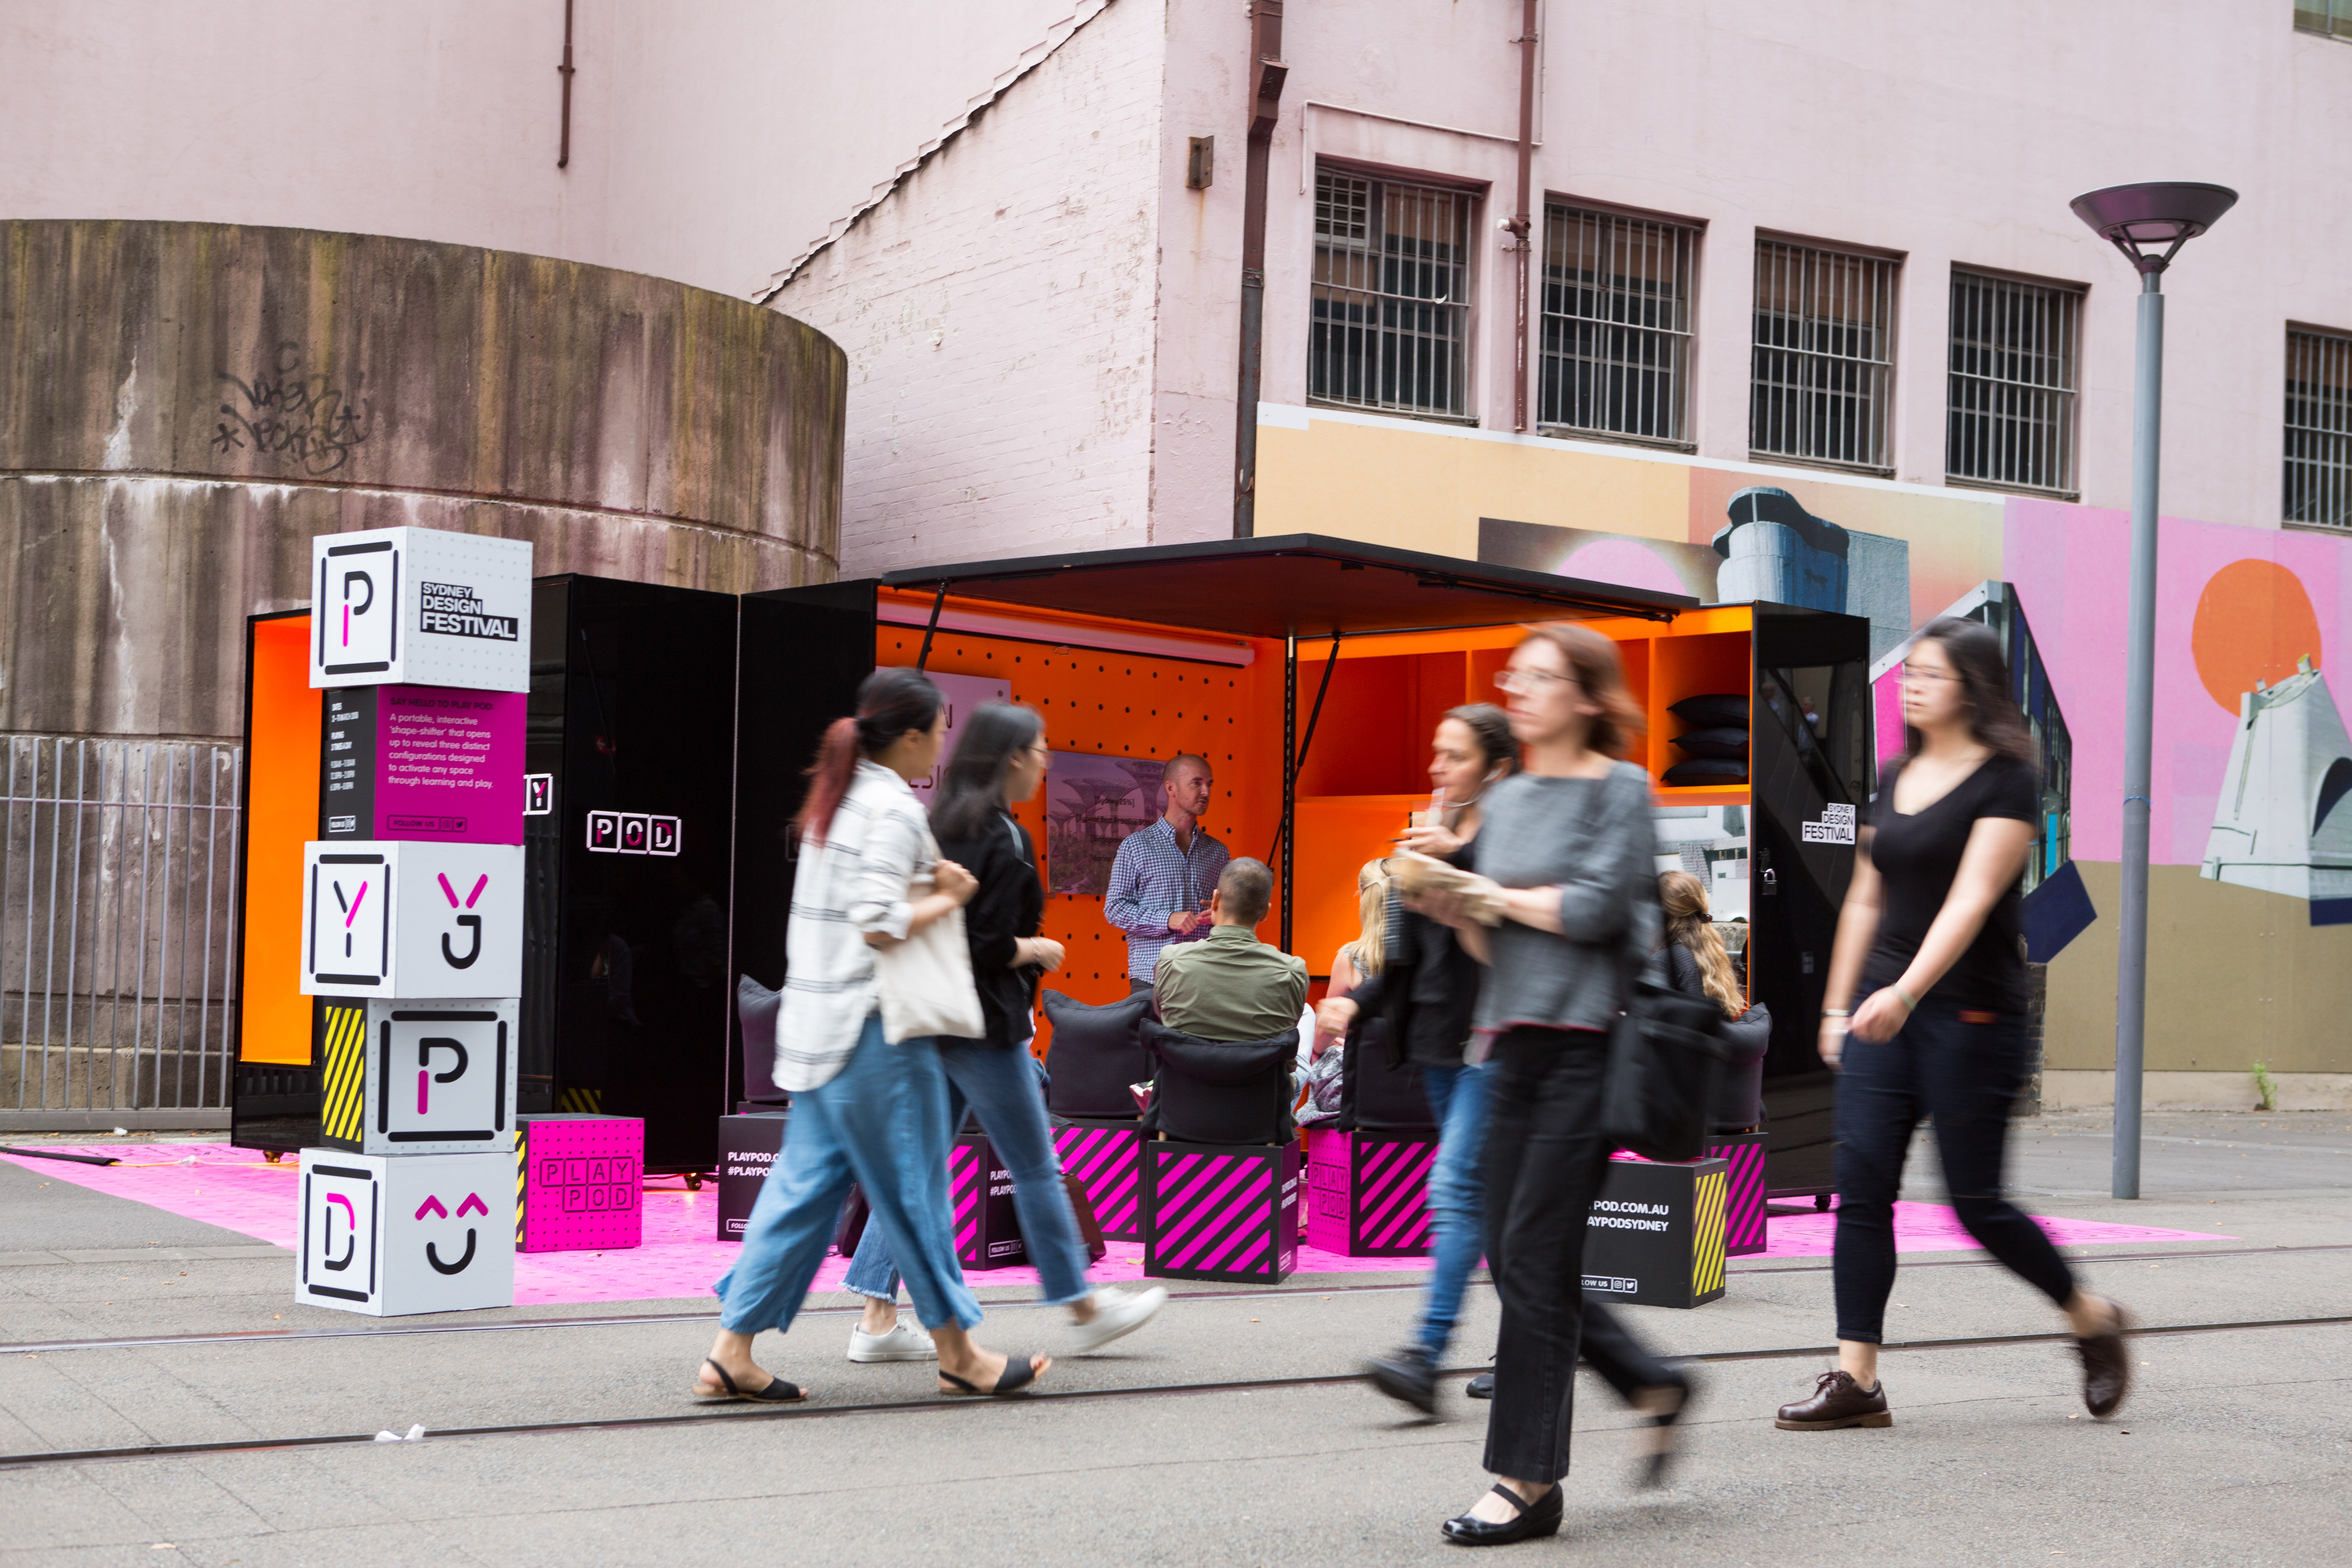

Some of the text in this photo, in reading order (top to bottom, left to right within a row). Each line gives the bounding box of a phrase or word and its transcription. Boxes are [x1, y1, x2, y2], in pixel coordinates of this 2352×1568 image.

[423, 583, 472, 598] SYDNEY
[343, 570, 374, 647] P
[423, 595, 482, 614] DESIGN
[422, 612, 516, 638] FESTIVAL
[409, 699, 435, 707] HELLO
[398, 715, 434, 724] portable,
[437, 716, 478, 725] interactive
[448, 728, 465, 737] that
[389, 739, 401, 748] up
[439, 740, 461, 749] three
[461, 741, 490, 751] distinct
[389, 751, 486, 764] configurations designed
[399, 764, 431, 773] activate
[432, 766, 448, 775] any
[449, 767, 474, 775] space
[388, 776, 494, 789] through learning and play.
[1829, 804, 1854, 813] SYDNEY
[1824, 814, 1853, 825] DESIGN
[596, 818, 672, 848] POD
[1805, 825, 1853, 841] FESTIVAL
[333, 880, 368, 958] Y
[417, 1037, 469, 1115] P
[547, 1162, 628, 1181] PLAY
[1314, 1167, 1345, 1189] PLAY
[570, 1188, 627, 1207] POD
[1322, 1194, 1344, 1214] POD
[1589, 1200, 1669, 1215] POD.COM.AU
[324, 1192, 356, 1272] D
